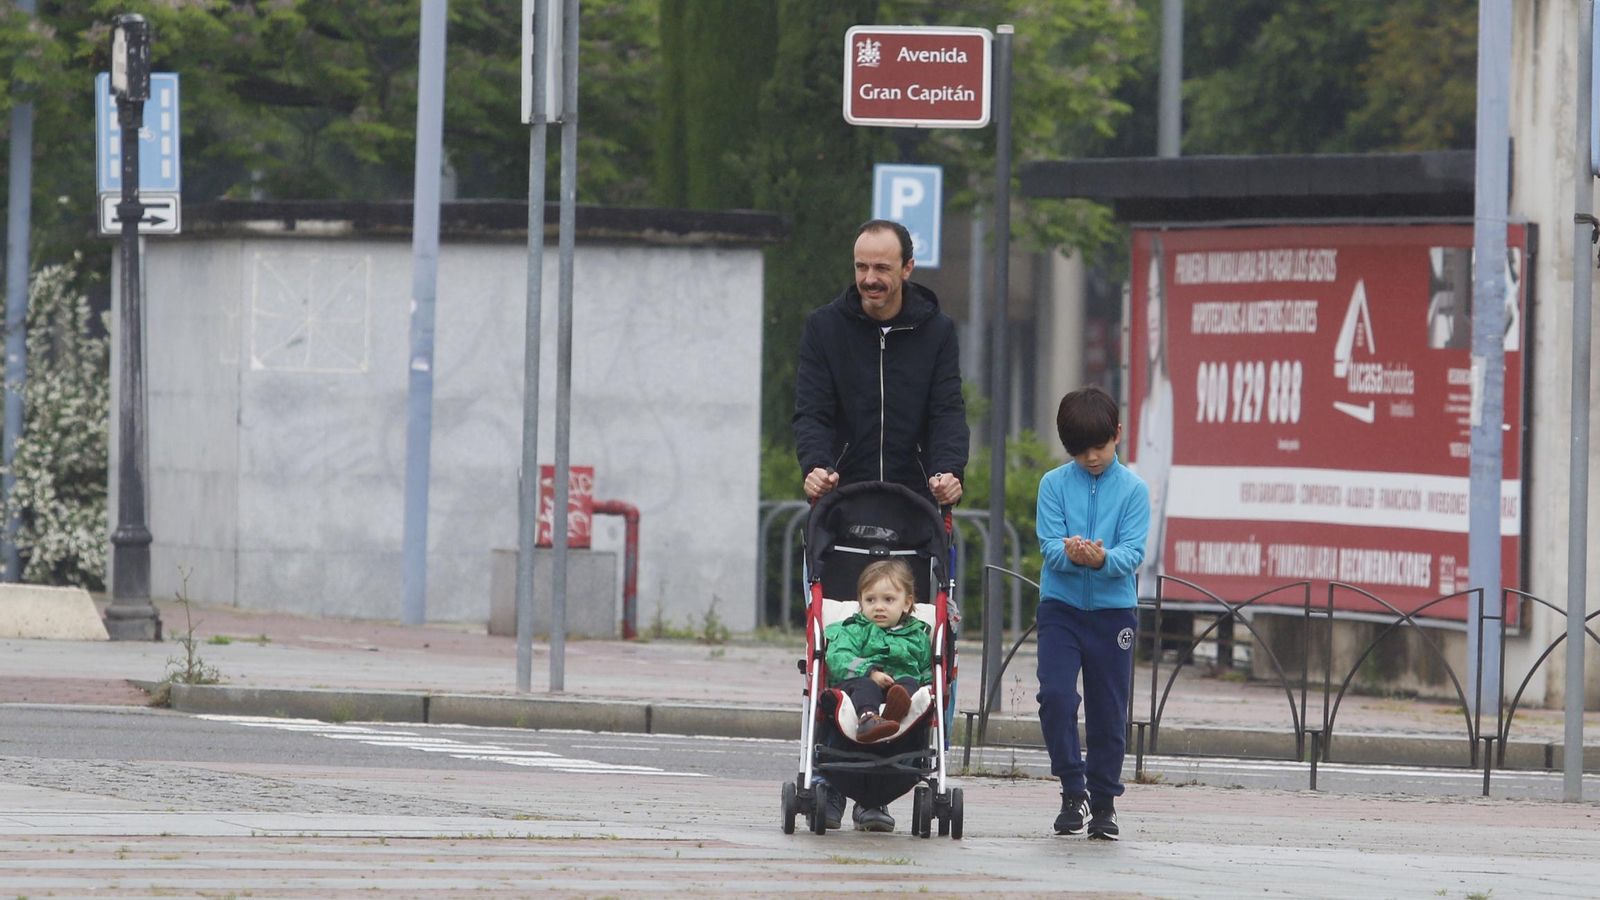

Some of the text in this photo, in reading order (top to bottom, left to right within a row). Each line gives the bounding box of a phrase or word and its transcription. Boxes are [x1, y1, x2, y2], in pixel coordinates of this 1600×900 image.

[896, 46, 968, 63] Avenida
[859, 83, 975, 104] Gran Capitán
[890, 177, 925, 219] P
[1293, 249, 1308, 282] LOS
[1308, 248, 1338, 282] GASTOS
[1247, 300, 1284, 334] NUESTROS
[1284, 300, 1318, 334] CLIENTES
[1196, 359, 1303, 425] 900 929 888
[1198, 535, 1262, 577] FINANCIACIÓN
